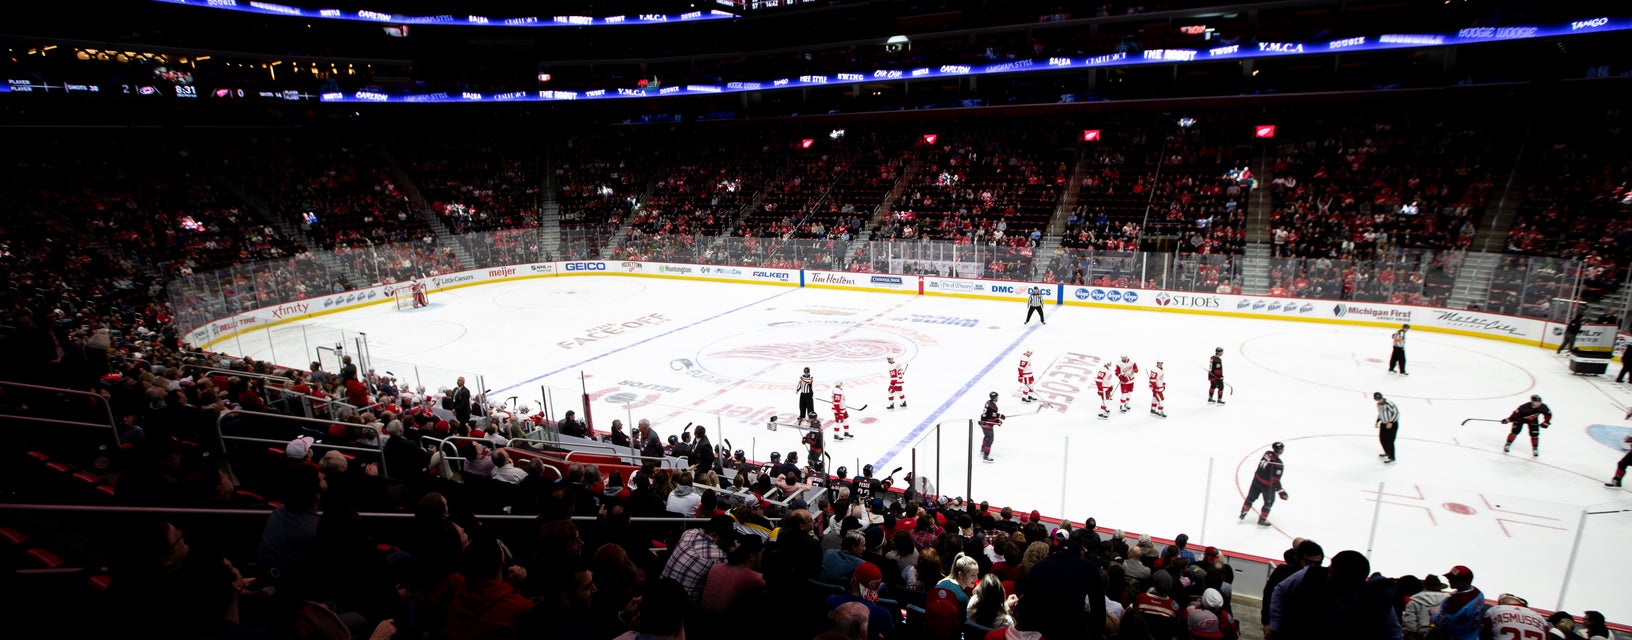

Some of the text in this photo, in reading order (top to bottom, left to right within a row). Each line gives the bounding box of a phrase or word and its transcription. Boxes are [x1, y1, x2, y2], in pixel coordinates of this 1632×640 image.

[358, 10, 392, 22] CARLTON
[468, 15, 488, 24] SALSA
[1570, 17, 1608, 31] TANGO
[1144, 50, 1197, 60] THE ROBOT
[1210, 44, 1240, 56] TWIST
[1048, 57, 1071, 66] SALSA
[940, 65, 970, 74] CARLTON
[122, 84, 130, 93] 2
[175, 85, 196, 94] 8:31
[355, 91, 388, 102] CARLTON
[462, 92, 482, 100] SALSA
[554, 91, 577, 100] ROBOT
[565, 262, 606, 271] GEICO
[665, 265, 692, 274] Huntington
[489, 266, 516, 278] meijer
[812, 273, 855, 286] Tim Hortons
[992, 286, 1014, 294] DMC
[1028, 288, 1051, 296] DCS
[1172, 295, 1220, 308] ST. JOE'S
[272, 302, 310, 319] xfinity
[1348, 307, 1411, 318] Michigan First
[557, 312, 666, 349] FACE-OFF
[617, 380, 681, 393] BELFOR
[1036, 352, 1101, 413] FACE-OFF
